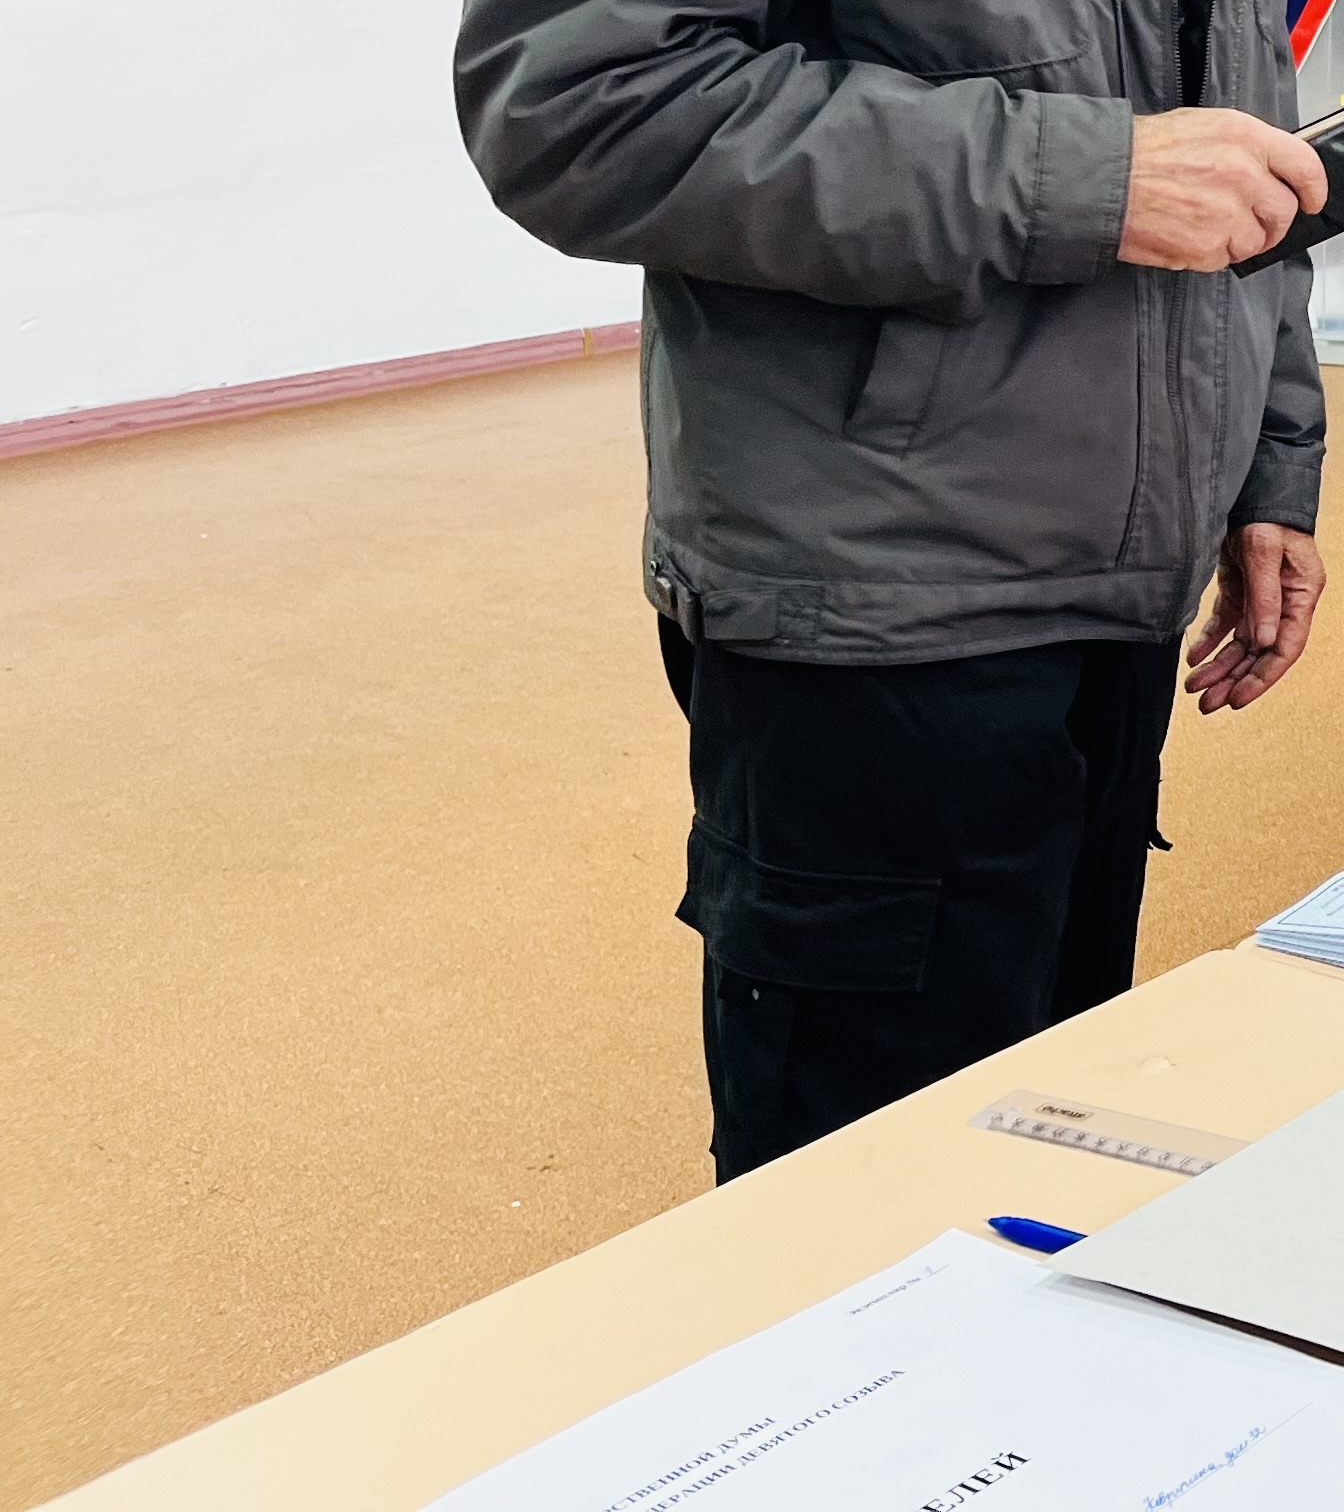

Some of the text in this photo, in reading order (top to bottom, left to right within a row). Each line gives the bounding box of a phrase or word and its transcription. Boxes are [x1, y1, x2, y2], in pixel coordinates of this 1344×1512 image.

[717, 1417, 777, 1455] ДУМЫ
[736, 1408, 831, 1467] ДЕВЯТОГО
[831, 1369, 907, 1410] СОЗЫВА
